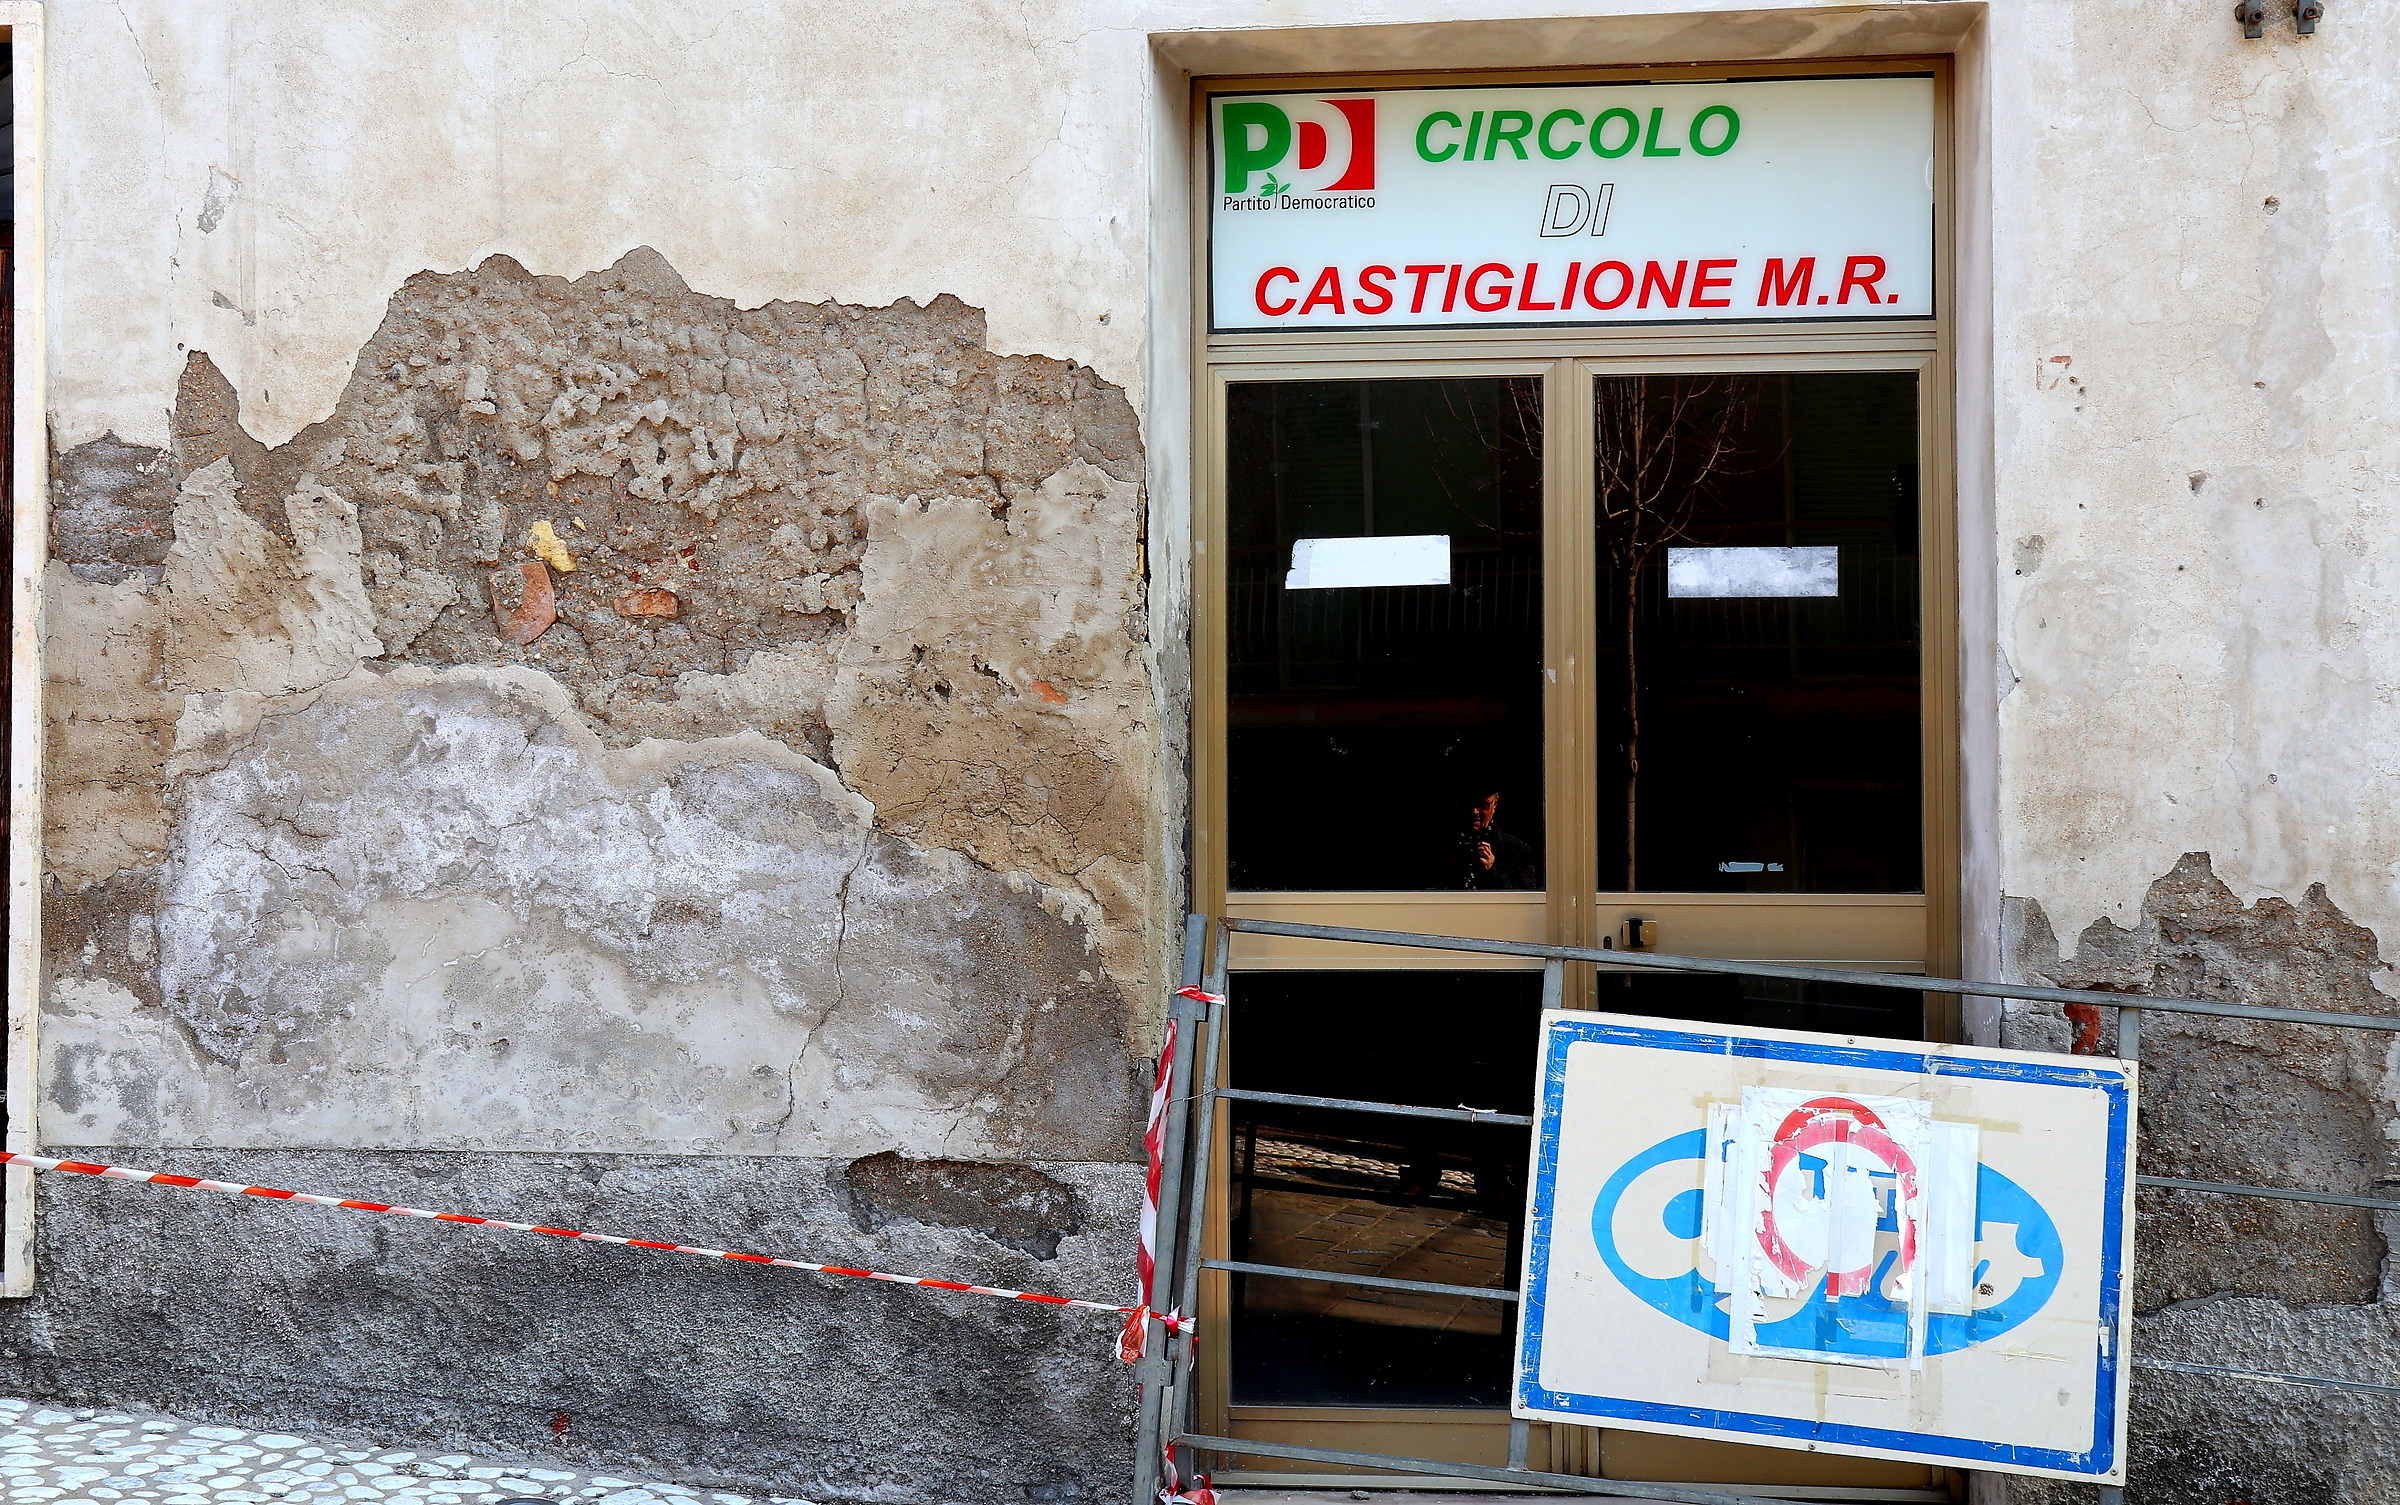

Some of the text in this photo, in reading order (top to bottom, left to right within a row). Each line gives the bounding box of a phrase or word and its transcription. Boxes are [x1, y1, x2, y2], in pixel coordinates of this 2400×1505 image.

[1222, 98, 1375, 194] PD
[1415, 104, 1741, 163] CIRCOLO
[1223, 192, 1376, 211] Partito Democratico
[1539, 183, 1615, 238] DI
[1254, 254, 1902, 316] CASTIGLIONE M.R.
